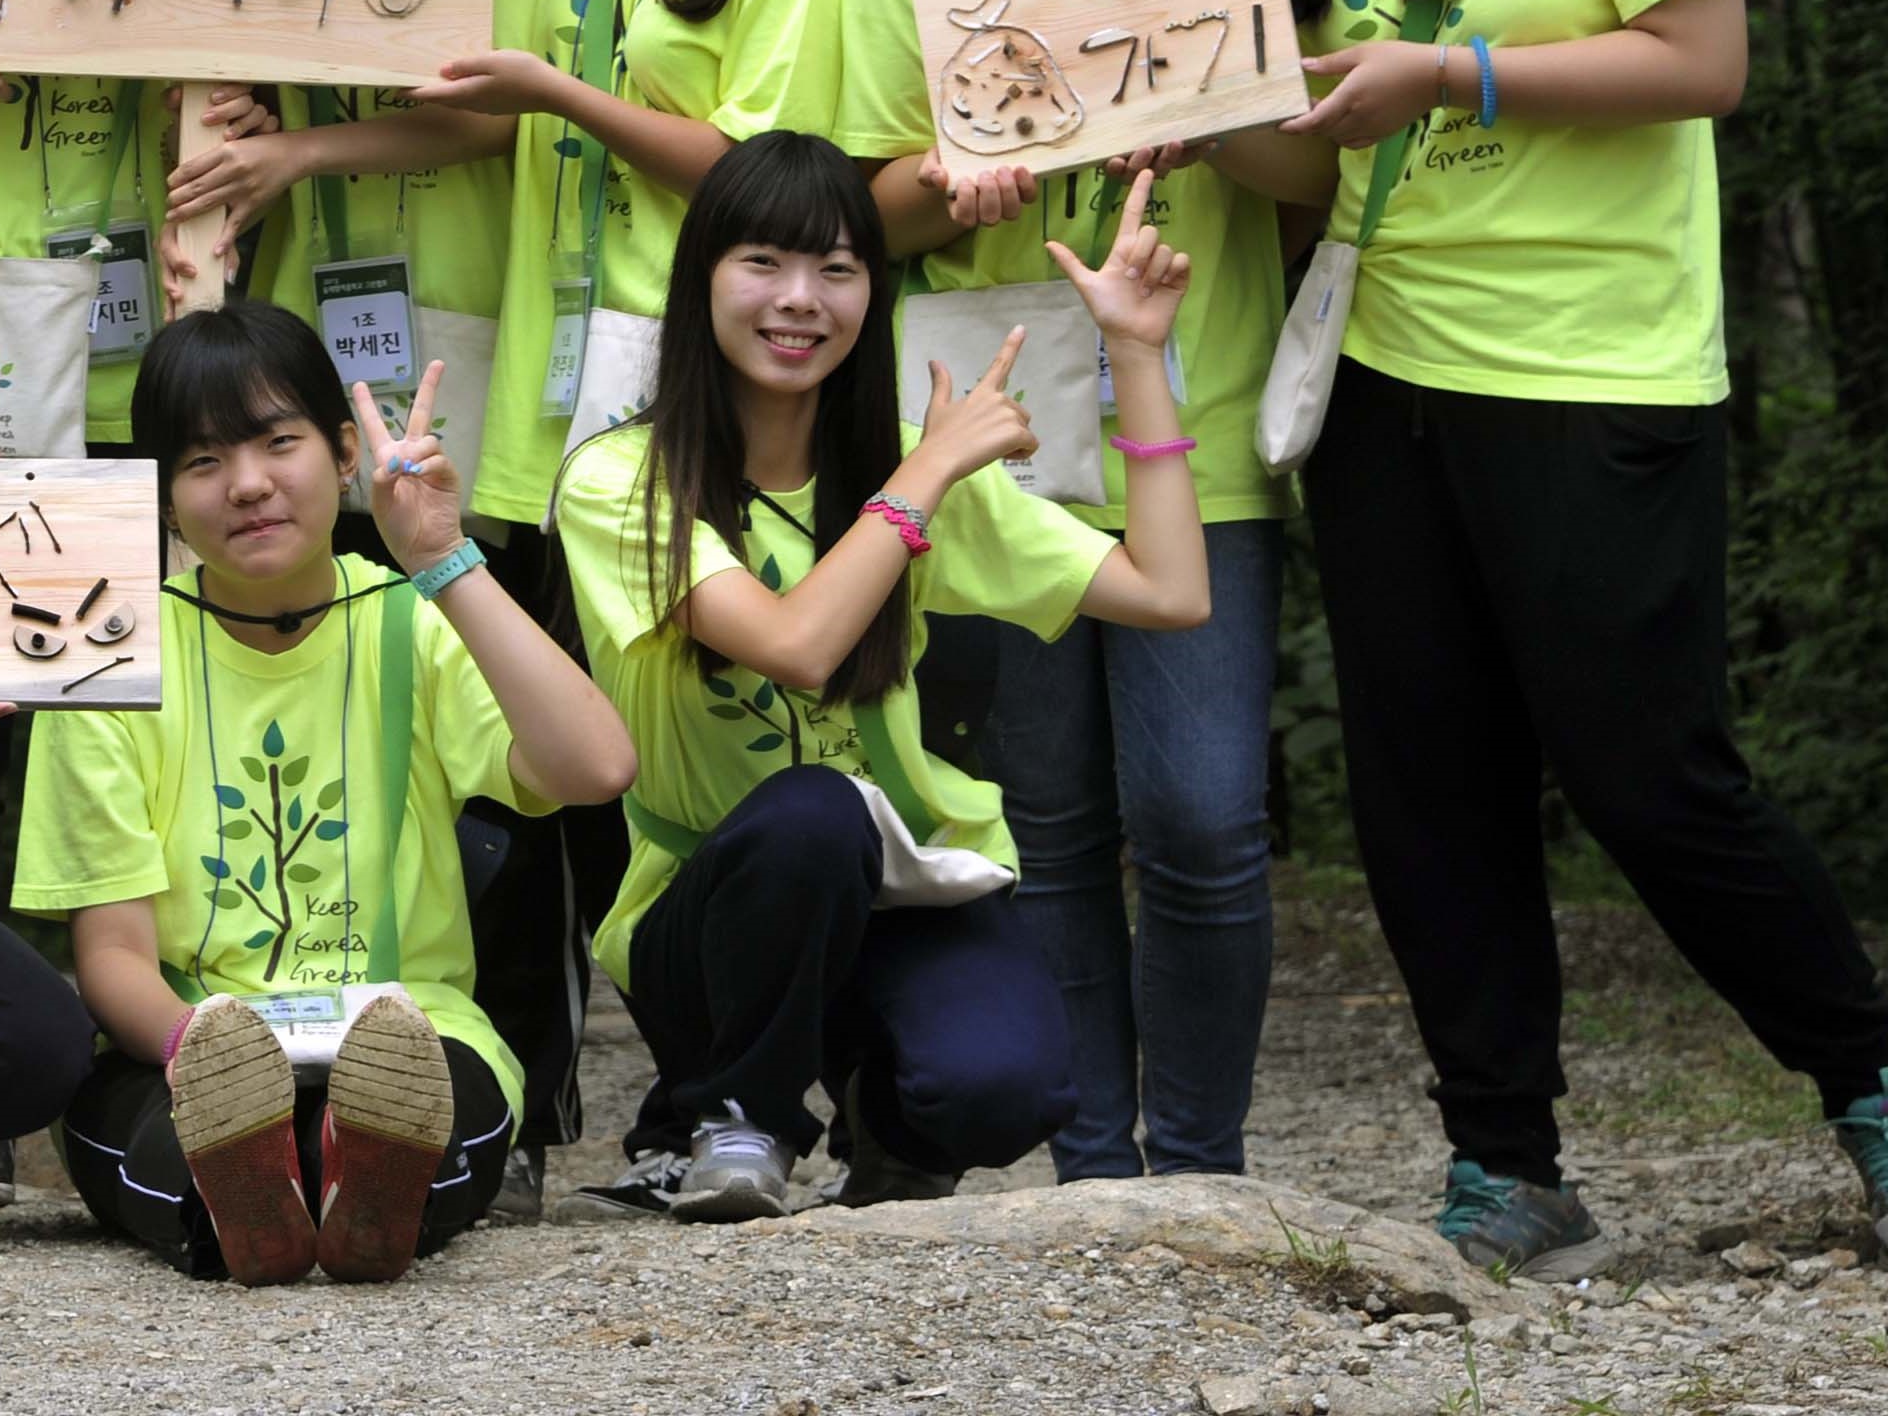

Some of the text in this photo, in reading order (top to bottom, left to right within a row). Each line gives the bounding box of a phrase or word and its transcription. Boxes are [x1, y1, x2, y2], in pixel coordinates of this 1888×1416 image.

[1078, 2, 1268, 104] 가기
[50, 88, 115, 116] Korea
[1425, 141, 1505, 172] Green
[97, 299, 141, 325] 지민
[351, 311, 377, 329] 1조
[335, 331, 402, 360] 박세진
[305, 893, 359, 921] Keep
[293, 930, 369, 955] Korea
